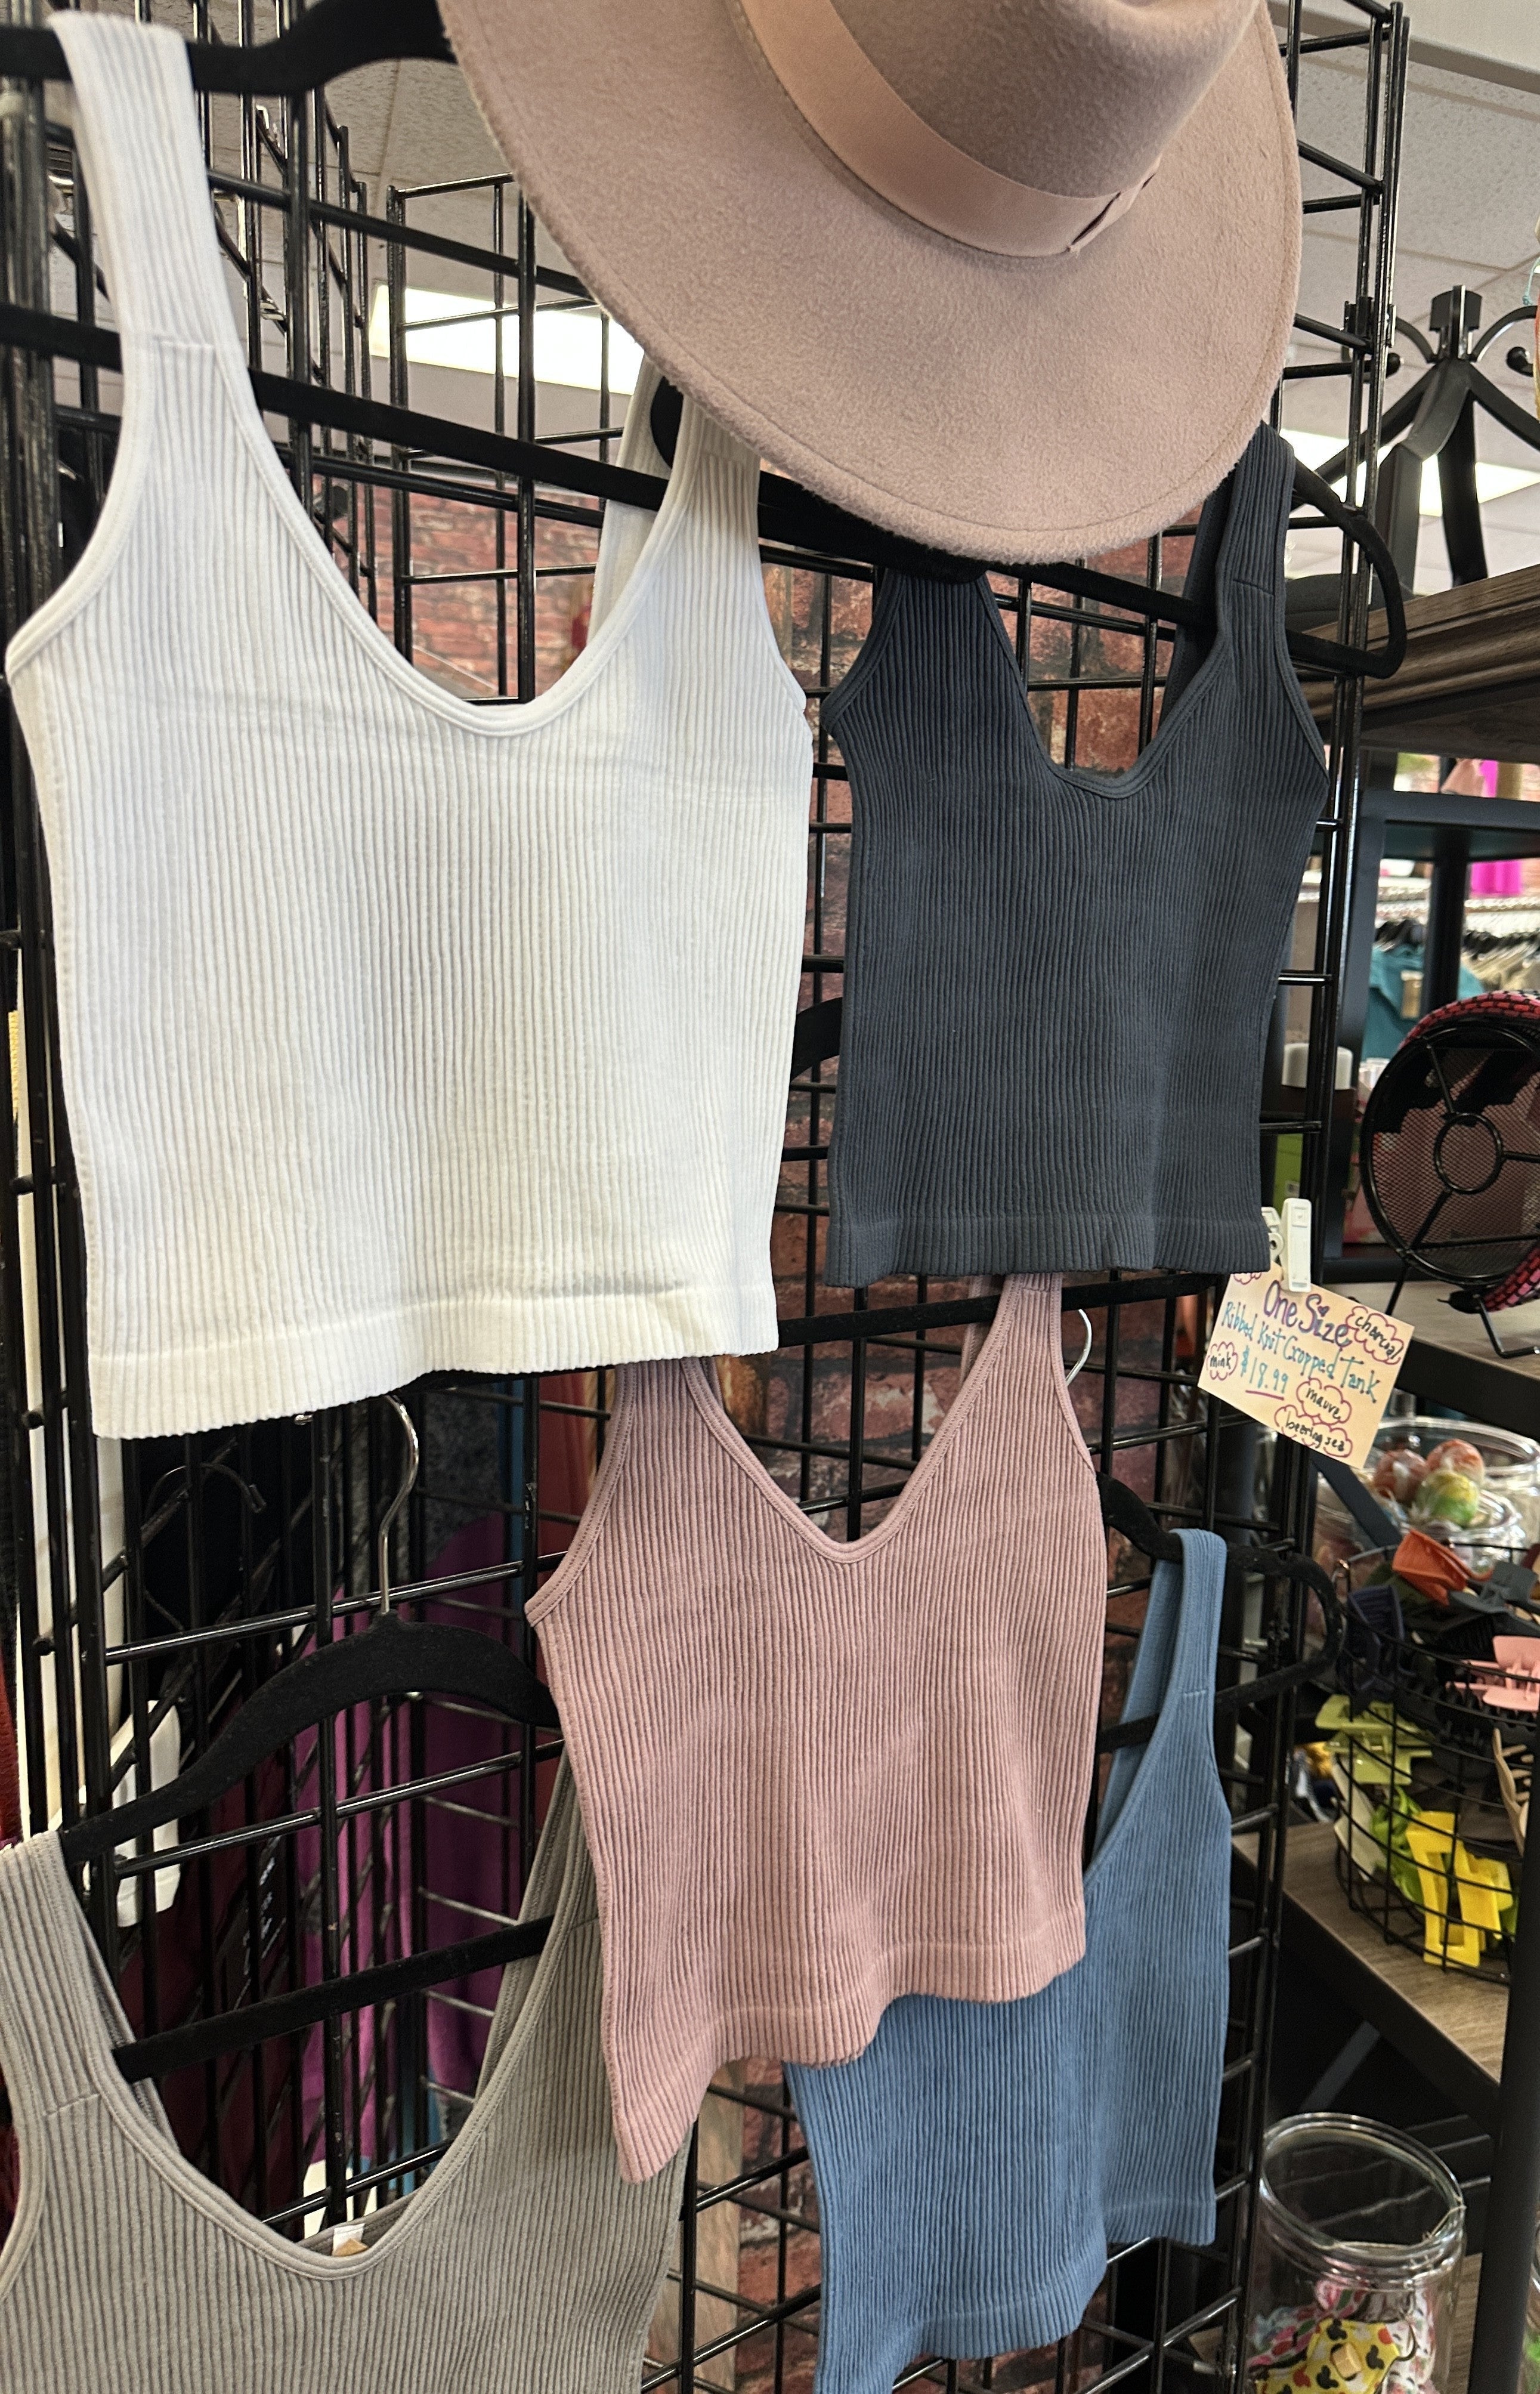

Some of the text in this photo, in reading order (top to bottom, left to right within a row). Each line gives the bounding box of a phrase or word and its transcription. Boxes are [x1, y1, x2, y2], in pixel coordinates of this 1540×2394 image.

[1263, 1280, 1353, 1348] One Size
[1355, 1314, 1404, 1359] charcoal
[1210, 1353, 1232, 1370] mink
[1221, 1301, 1381, 1403] Ribbed Knit Cropped Tank
[1240, 1345, 1288, 1394] $18.99
[1306, 1388, 1341, 1420] mauve
[1325, 1437, 1344, 1452] sea
